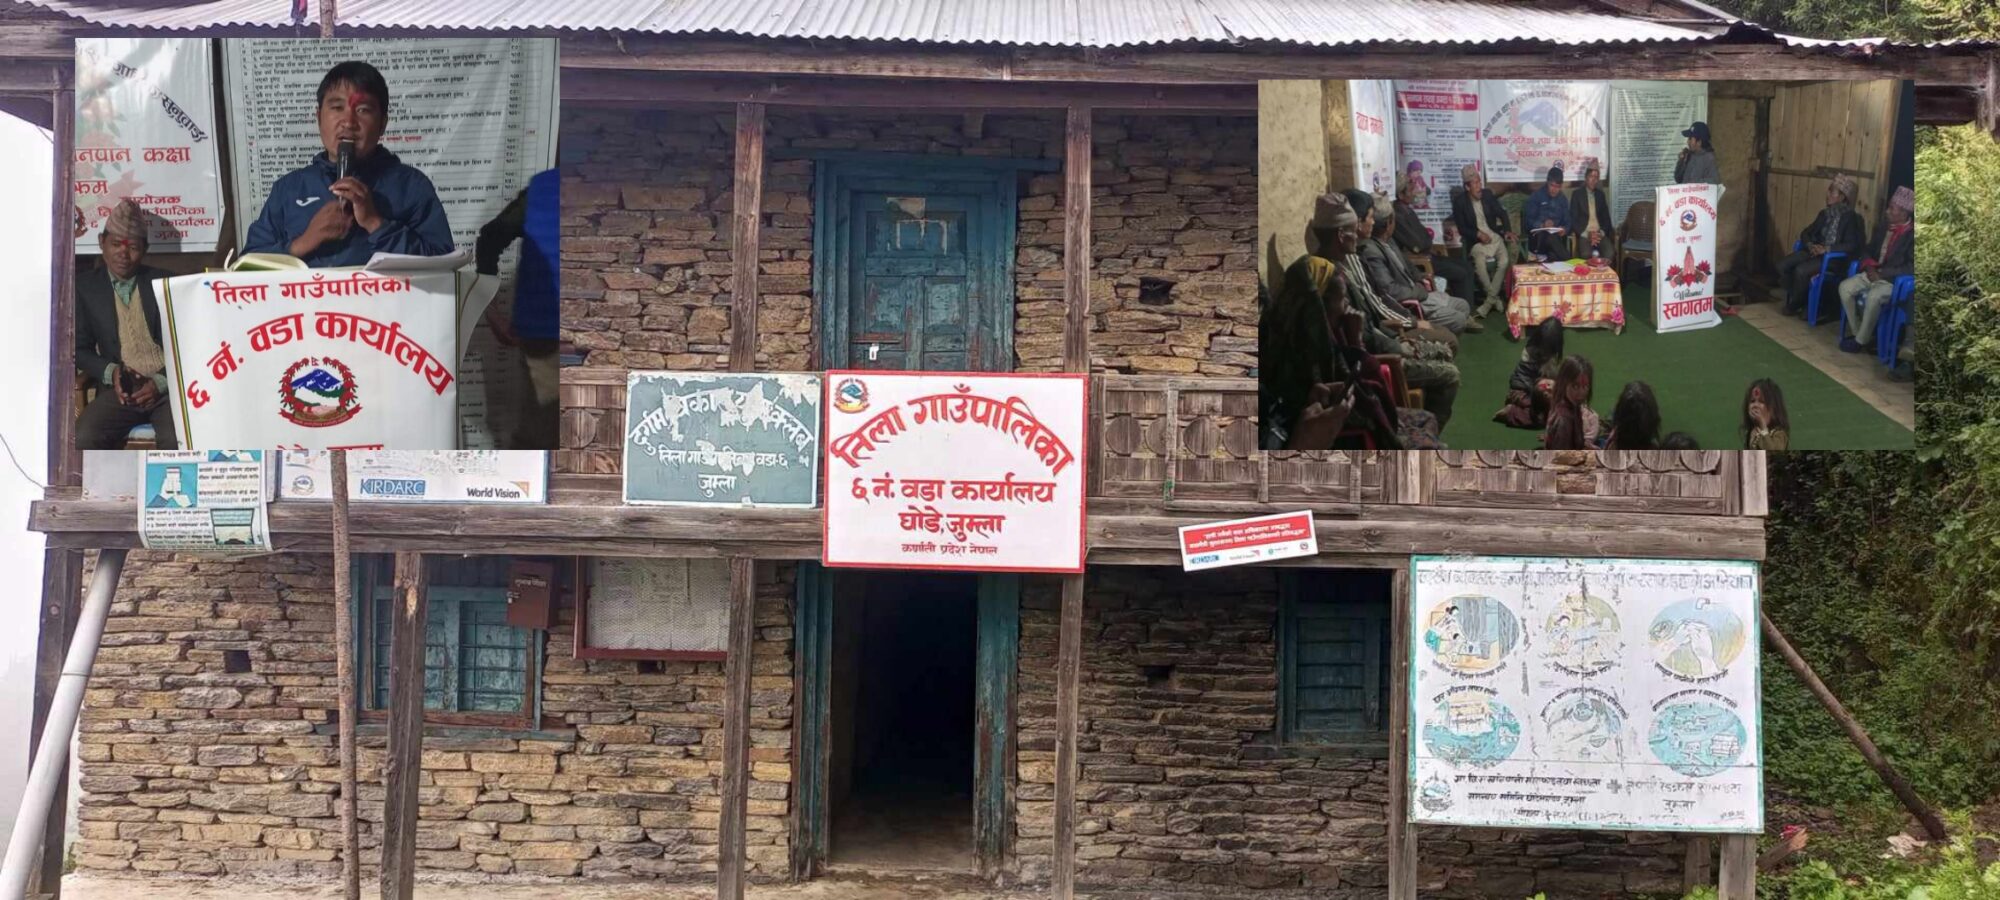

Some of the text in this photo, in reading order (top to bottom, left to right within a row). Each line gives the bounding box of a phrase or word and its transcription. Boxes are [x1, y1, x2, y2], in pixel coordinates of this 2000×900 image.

[143, 146, 191, 163] कक्षा
[1674, 196, 1687, 209] वडा
[212, 272, 413, 304] तिला गाउँपालिका
[186, 311, 455, 409] ६ नं. वडा कार्यालय
[830, 406, 907, 469] तिला
[907, 383, 1075, 477] गाउँपालिका
[658, 444, 687, 467] तिला
[360, 478, 521, 499] KIRDARC World Vision
[697, 473, 738, 498] जुम्ला
[852, 471, 1057, 505] ६ नं. वडा कार्यालय
[945, 513, 1006, 542] जुम्ला
[940, 543, 967, 557] प्रदेश
[969, 543, 998, 554] नेपाल
